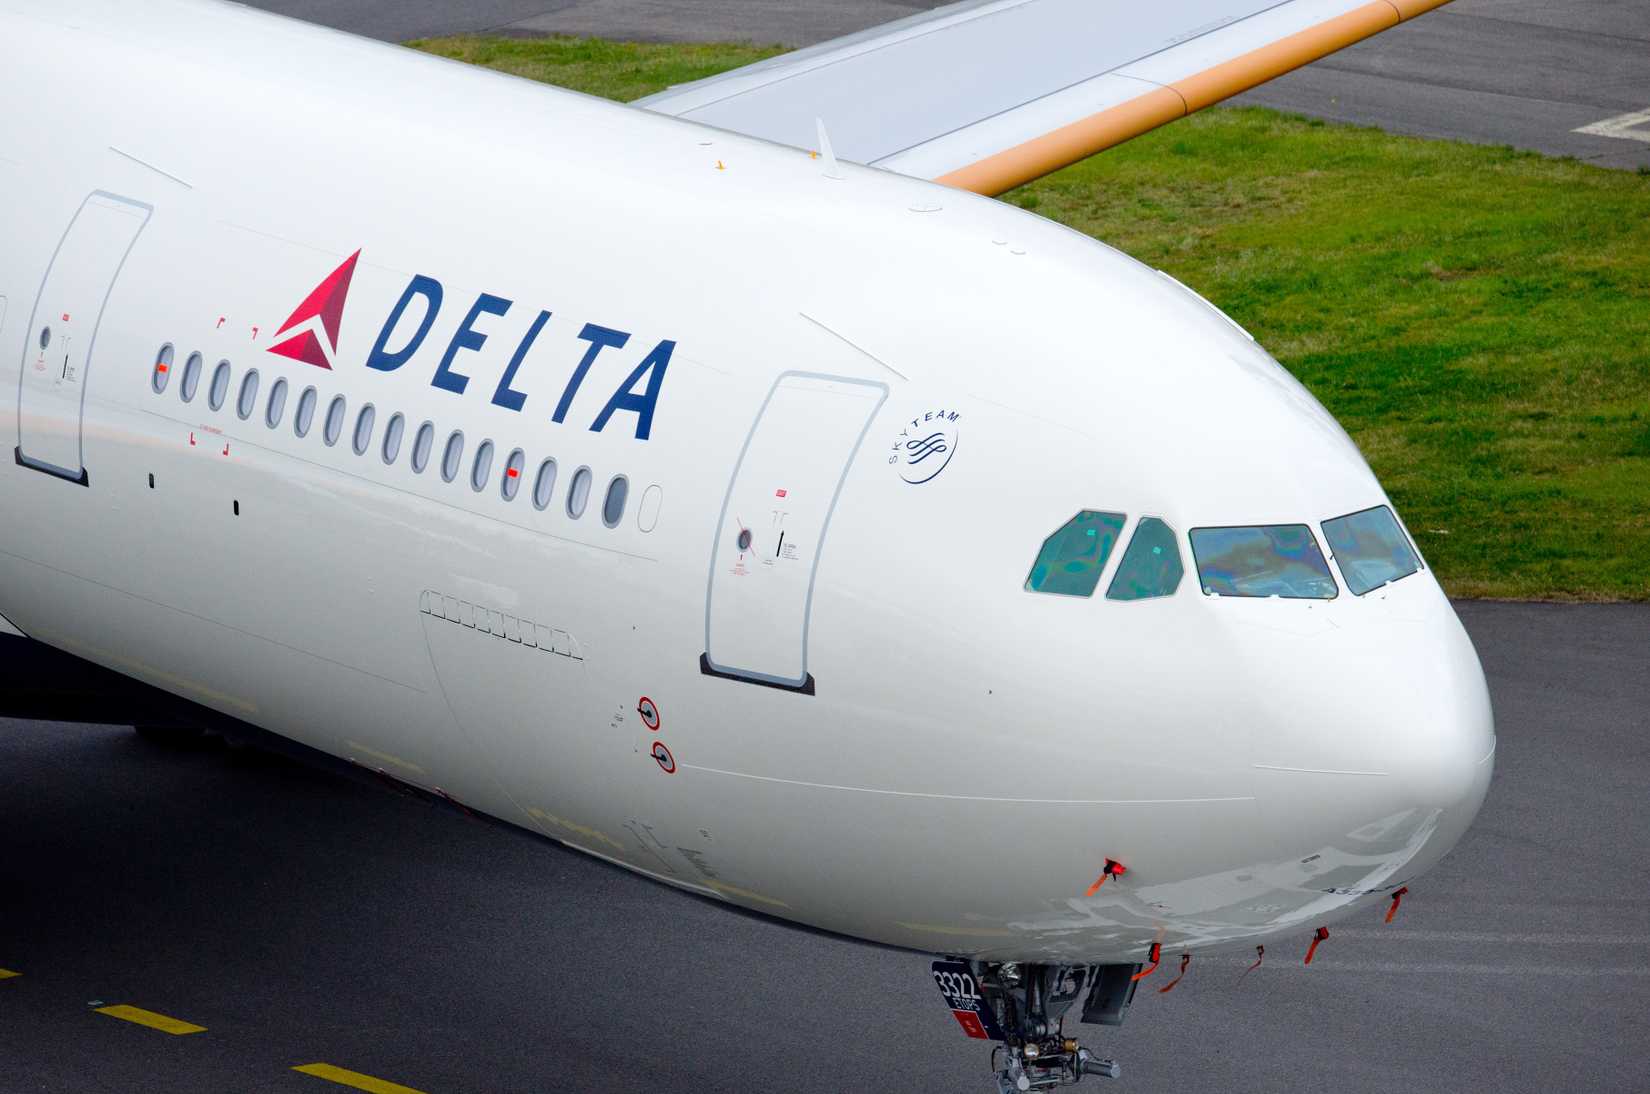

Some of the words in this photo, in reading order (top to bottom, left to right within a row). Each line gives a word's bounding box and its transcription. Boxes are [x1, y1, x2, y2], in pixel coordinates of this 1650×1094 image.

[365, 273, 677, 441] DELTA
[933, 970, 982, 999] 3322
[951, 997, 981, 1011] ETOPS
